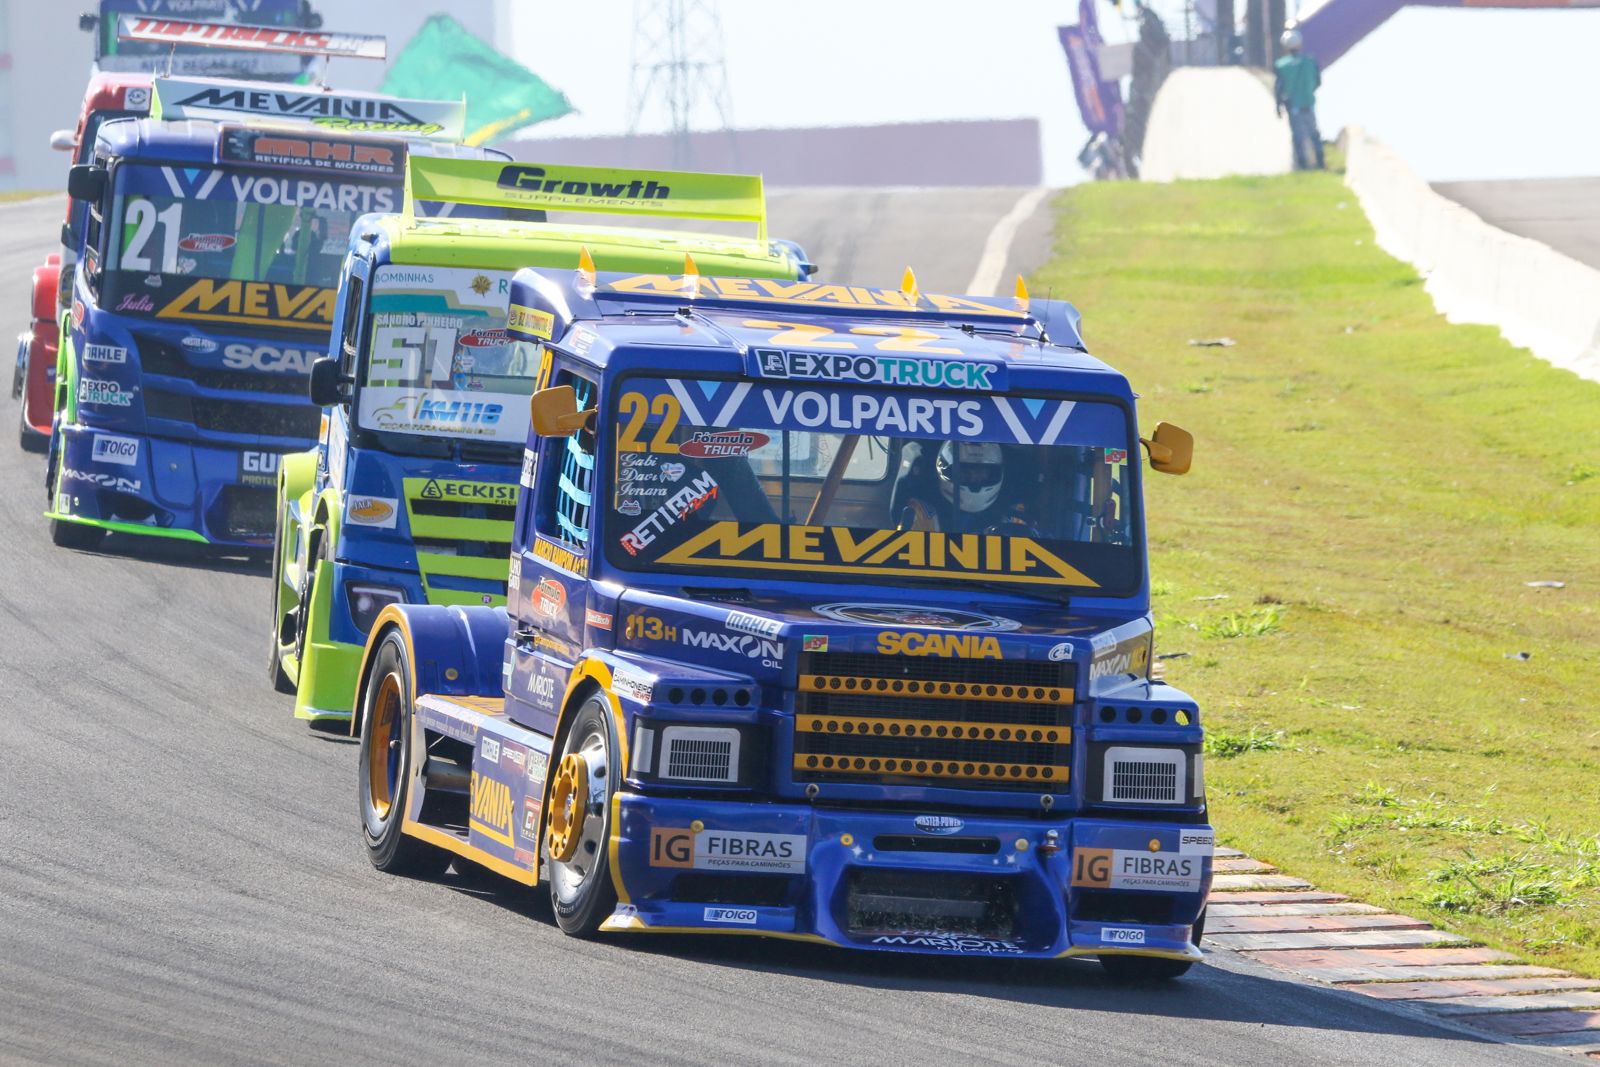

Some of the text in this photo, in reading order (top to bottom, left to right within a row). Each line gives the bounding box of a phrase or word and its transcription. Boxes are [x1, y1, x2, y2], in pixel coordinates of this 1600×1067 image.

[172, 88, 432, 127] MEVANIA
[254, 137, 394, 166] MHR
[315, 160, 331, 168] DE
[334, 162, 394, 173] MOTORES
[496, 164, 671, 200] Growth
[231, 175, 394, 213] VOLPARTS
[120, 198, 183, 274] 21
[374, 271, 435, 284] BOMBINHAS
[115, 292, 155, 312] Julia
[155, 278, 334, 331] MEVA
[376, 313, 464, 329] SANDRO PINHEIRO
[477, 337, 511, 346] TRUCK
[372, 327, 456, 381] 51
[88, 381, 119, 393] EXPO
[88, 391, 129, 405] TRUCK
[618, 391, 682, 454] 22
[762, 388, 984, 437] VOLPARTS
[104, 439, 136, 456] TOIGO
[692, 431, 754, 445] Fórmula
[620, 453, 658, 467] Gabi
[702, 444, 750, 456] TRUCK
[61, 467, 142, 490] MAXON
[653, 521, 1102, 588] MEVANIA
[727, 610, 778, 636] MAHLE
[682, 628, 784, 660] MAXON
[876, 631, 1003, 660] SCANIA
[762, 658, 783, 670] OIL
[653, 834, 793, 863] IG FIBRAS
[706, 858, 730, 868] PEÇAS
[750, 860, 792, 869] CAMINHÕES
[1075, 854, 1192, 883] IG FIBRAS
[718, 909, 756, 921] TOIGO
[871, 935, 1020, 950] MARIOTE
[1111, 930, 1144, 941] TOIGO
